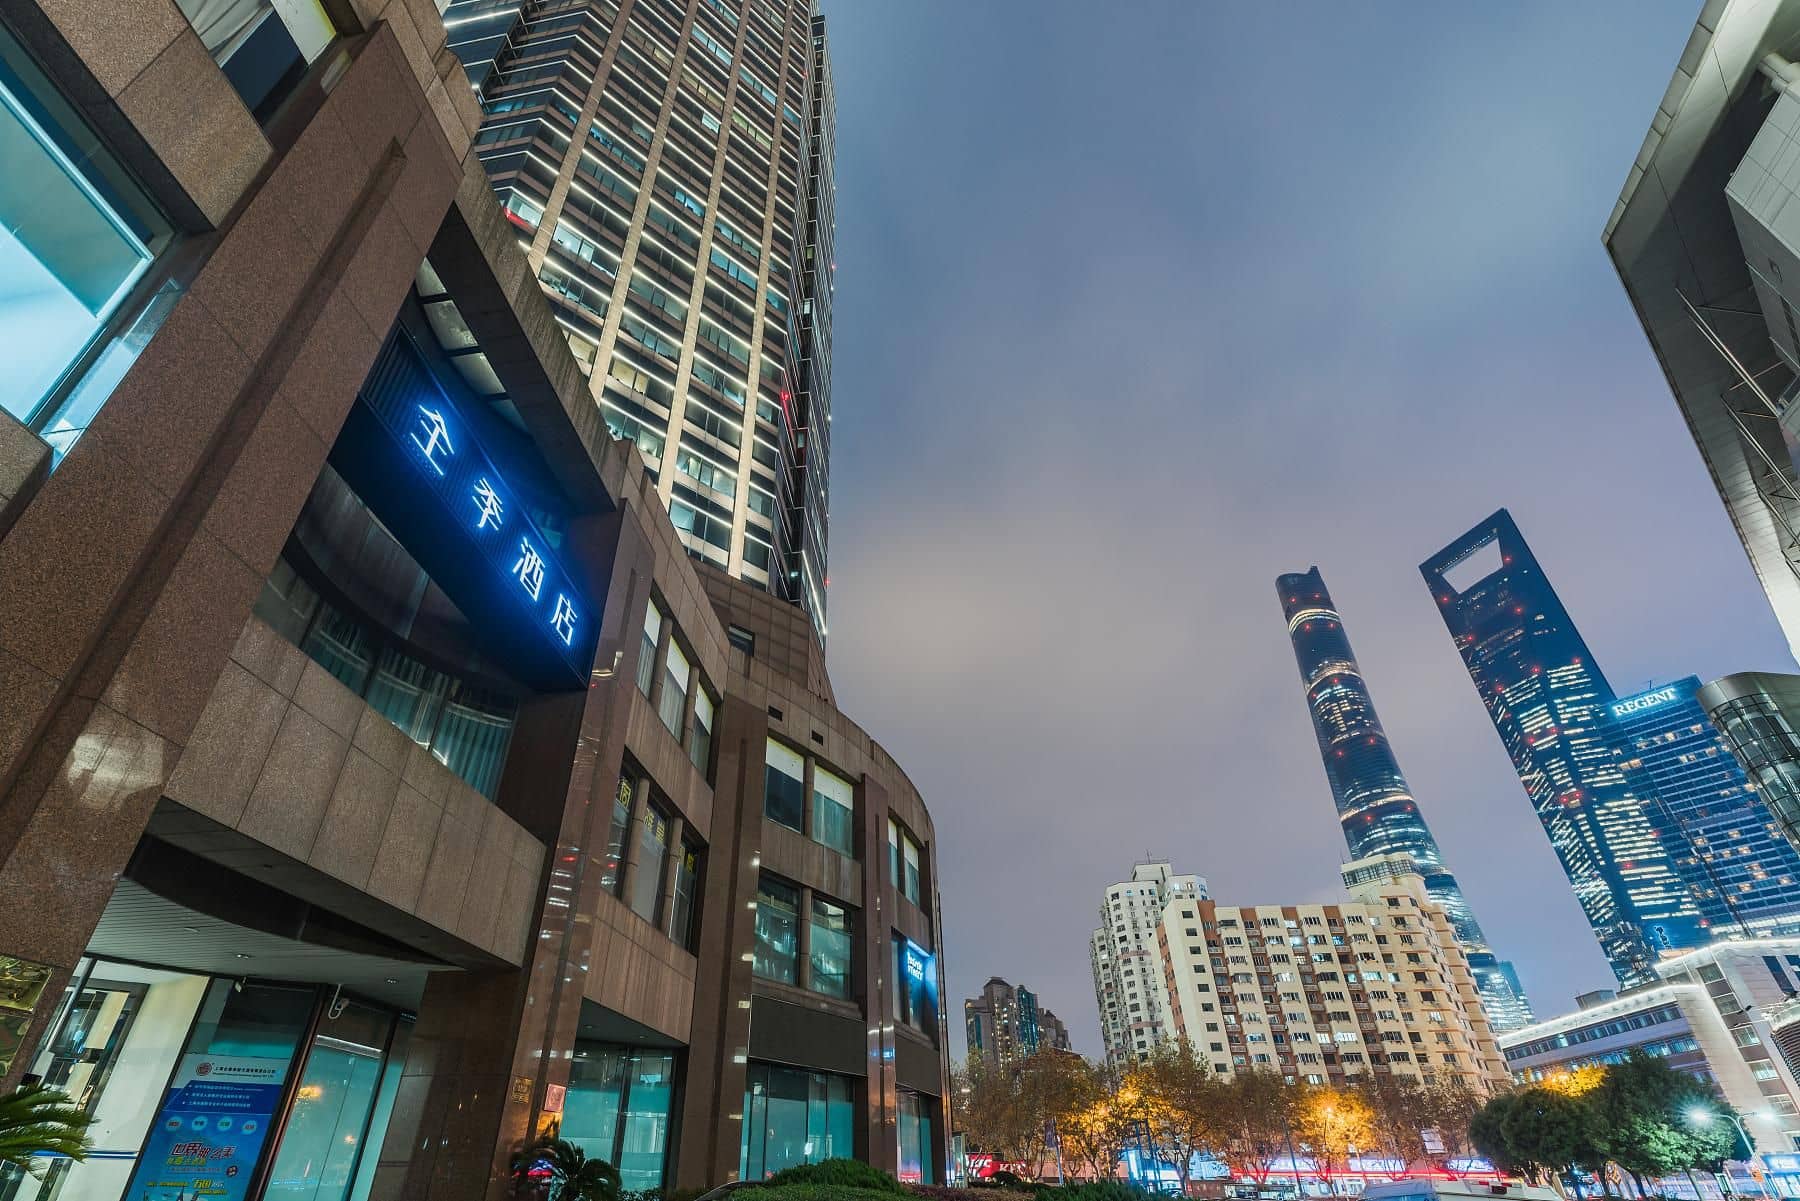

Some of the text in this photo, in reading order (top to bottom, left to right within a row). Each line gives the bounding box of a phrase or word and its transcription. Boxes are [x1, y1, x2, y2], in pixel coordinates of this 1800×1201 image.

[410, 404, 578, 646] 全季酒店
[1612, 687, 1676, 716] REGENT
